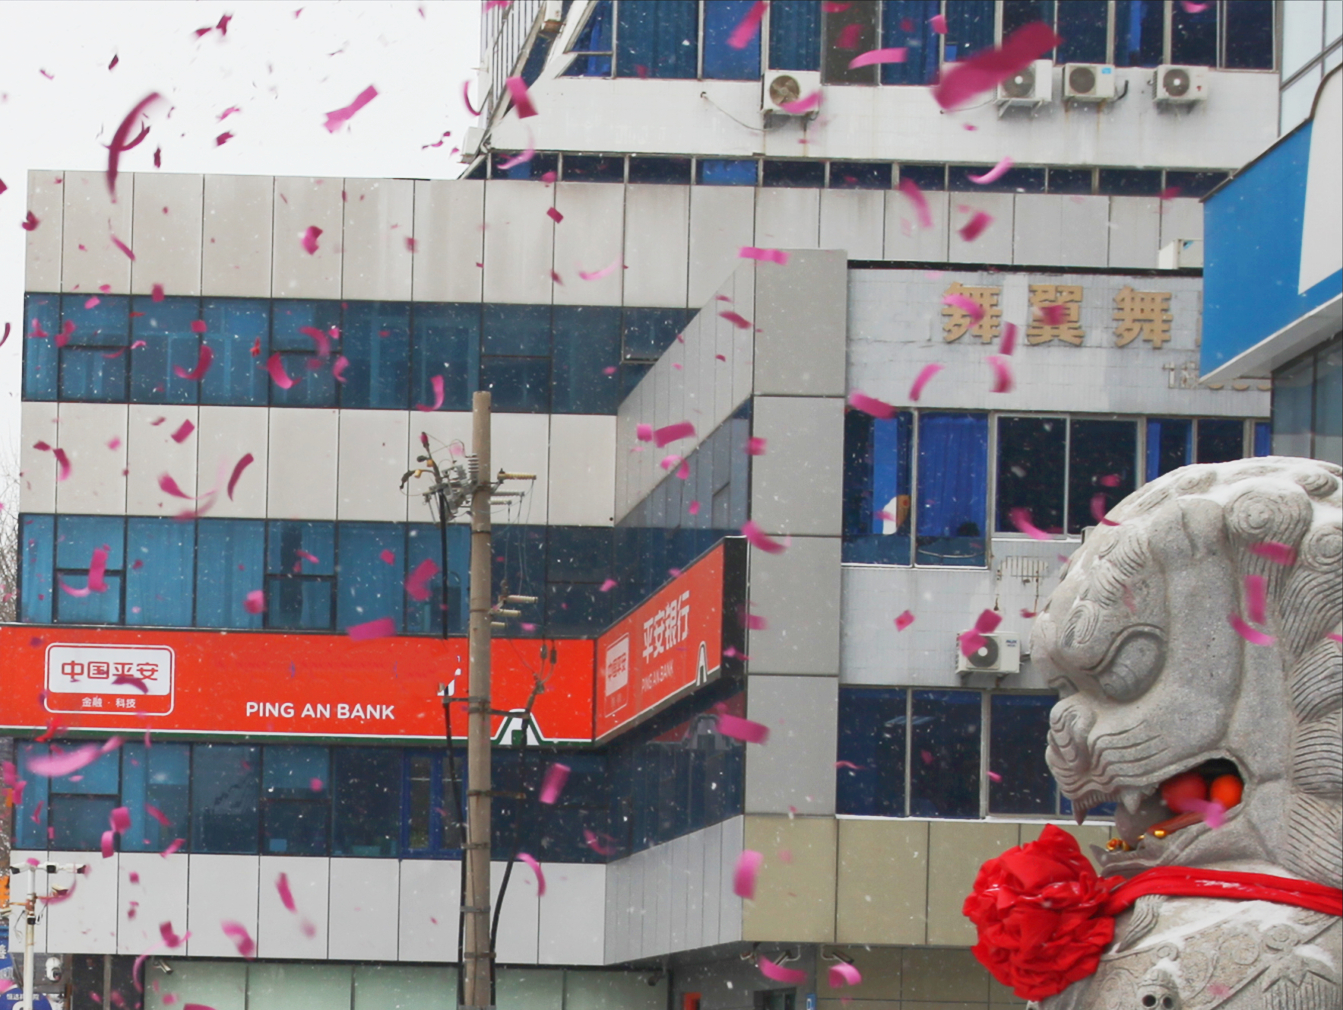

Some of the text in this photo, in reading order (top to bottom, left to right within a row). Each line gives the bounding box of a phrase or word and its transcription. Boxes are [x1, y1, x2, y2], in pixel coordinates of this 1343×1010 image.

[941, 281, 1202, 349] 舞翼舞
[642, 590, 690, 664] 平安银行
[61, 660, 159, 681] 中国平安
[246, 702, 395, 720] PING AN BANK
